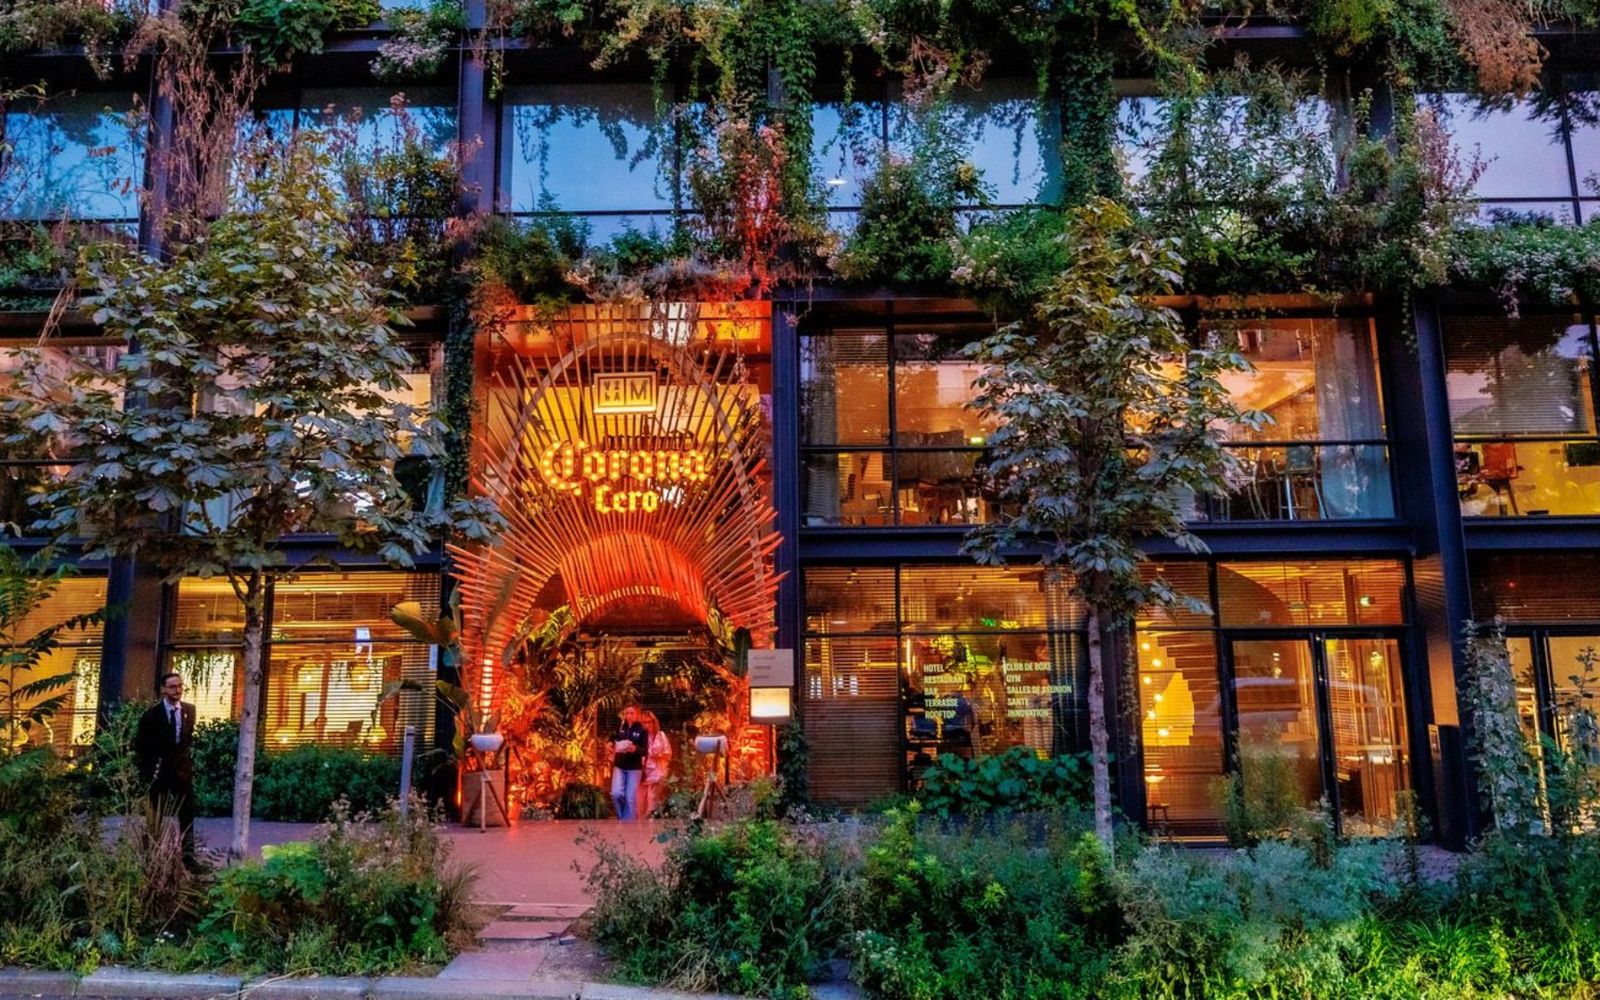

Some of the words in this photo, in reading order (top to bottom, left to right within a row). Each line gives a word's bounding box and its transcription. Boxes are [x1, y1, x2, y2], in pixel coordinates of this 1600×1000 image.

[630, 379, 648, 400] M
[540, 439, 709, 496] Corona
[594, 485, 658, 513] Cero
[1006, 662, 1024, 671] CLUB
[1024, 662, 1033, 671] DE
[924, 674, 967, 684] RESTAURANT
[1006, 674, 1021, 683] GYM
[1006, 685, 1031, 695] SALLES
[1032, 685, 1040, 694] DE
[924, 698, 958, 707] TERRASSE
[925, 710, 957, 719] ROOFTOP
[1007, 709, 1049, 718] INNOVATION
